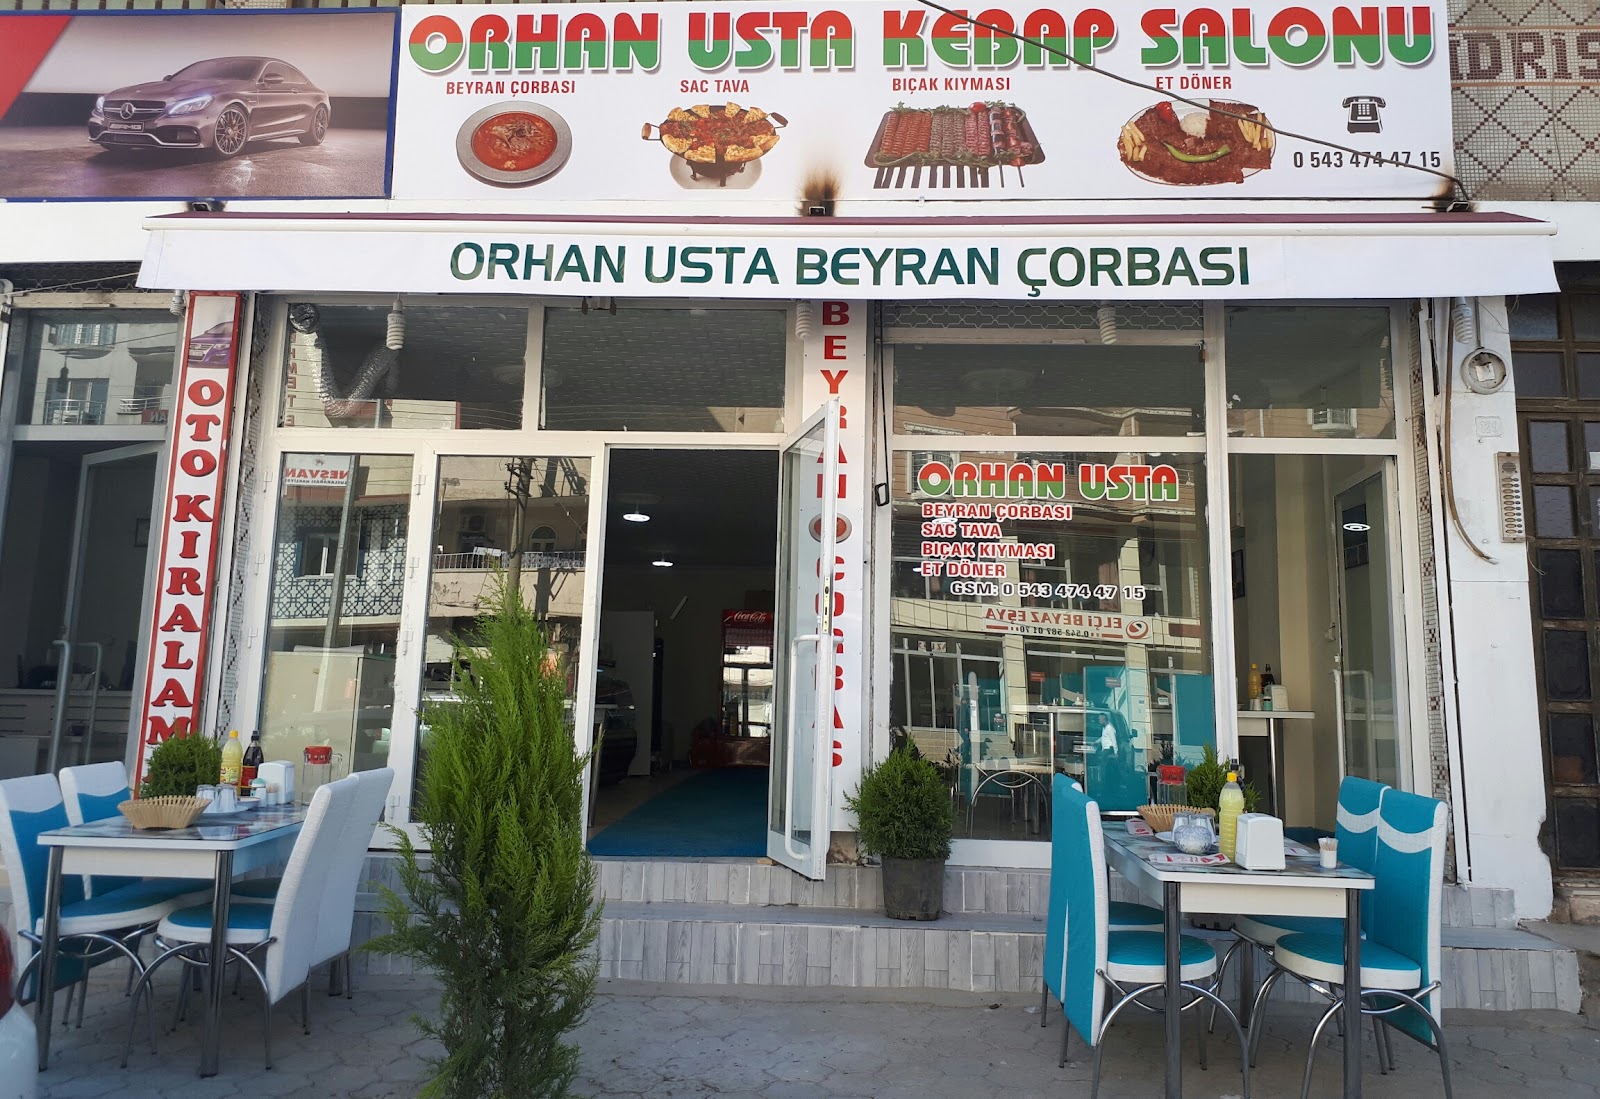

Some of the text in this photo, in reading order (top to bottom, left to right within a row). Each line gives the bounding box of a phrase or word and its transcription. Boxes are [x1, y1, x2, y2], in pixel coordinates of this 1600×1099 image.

[408, 6, 1435, 71] ORHAN USTA KEBAP SALONU
[446, 80, 576, 98] BEYRAN ÇORBASI
[680, 79, 750, 93] SAC TAVA
[892, 77, 1011, 95] BIÇAK KIYMASI
[1156, 74, 1233, 91] ET DÖNER
[1293, 151, 1442, 170] 0 543 474 47 15
[450, 242, 1251, 297] ORHAN USTA BEYRAN ÇORBASI
[918, 461, 1179, 501] ORHAN USTA
[923, 504, 1072, 522] BEYRAN ÇORBASI
[922, 523, 1001, 538] SAC TAVA
[922, 542, 1055, 560] BIÇAK KIYMASI
[922, 560, 1006, 578] ET DÖNER
[142, 378, 225, 784] OTO KIRALAM
[951, 582, 1146, 599] GSM: 0 543 474 47 15
